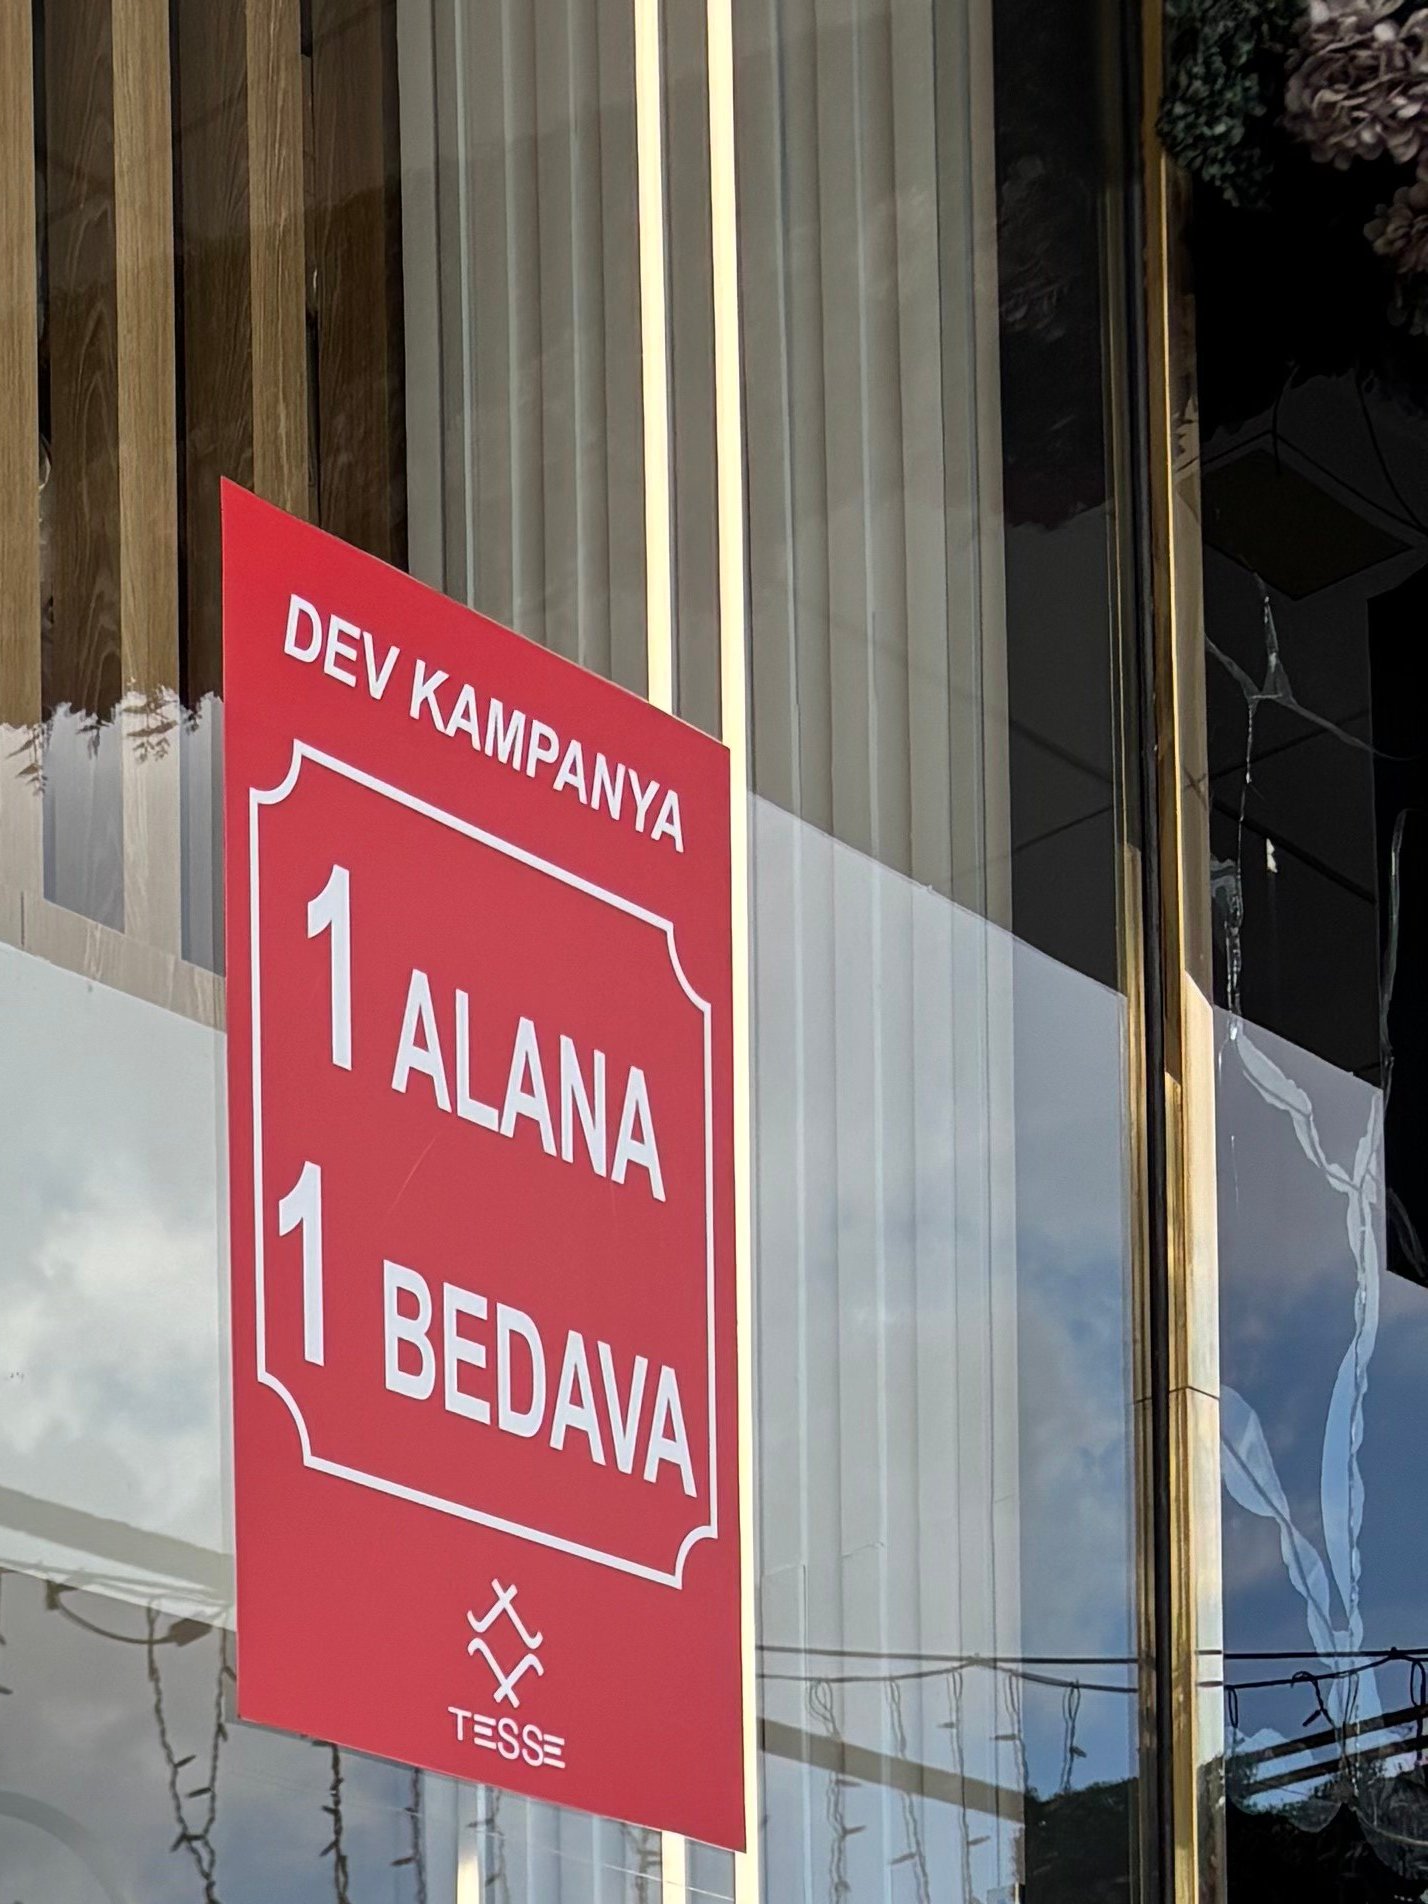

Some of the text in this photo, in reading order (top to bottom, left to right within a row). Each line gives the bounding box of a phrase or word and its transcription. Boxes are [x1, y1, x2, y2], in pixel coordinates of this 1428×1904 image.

[283, 592, 685, 854] DEV KAMPANYA
[306, 863, 667, 1203] 1 ALANA
[277, 1159, 699, 1499] 1 BEDAVA
[447, 1706, 566, 1770] TESSE
